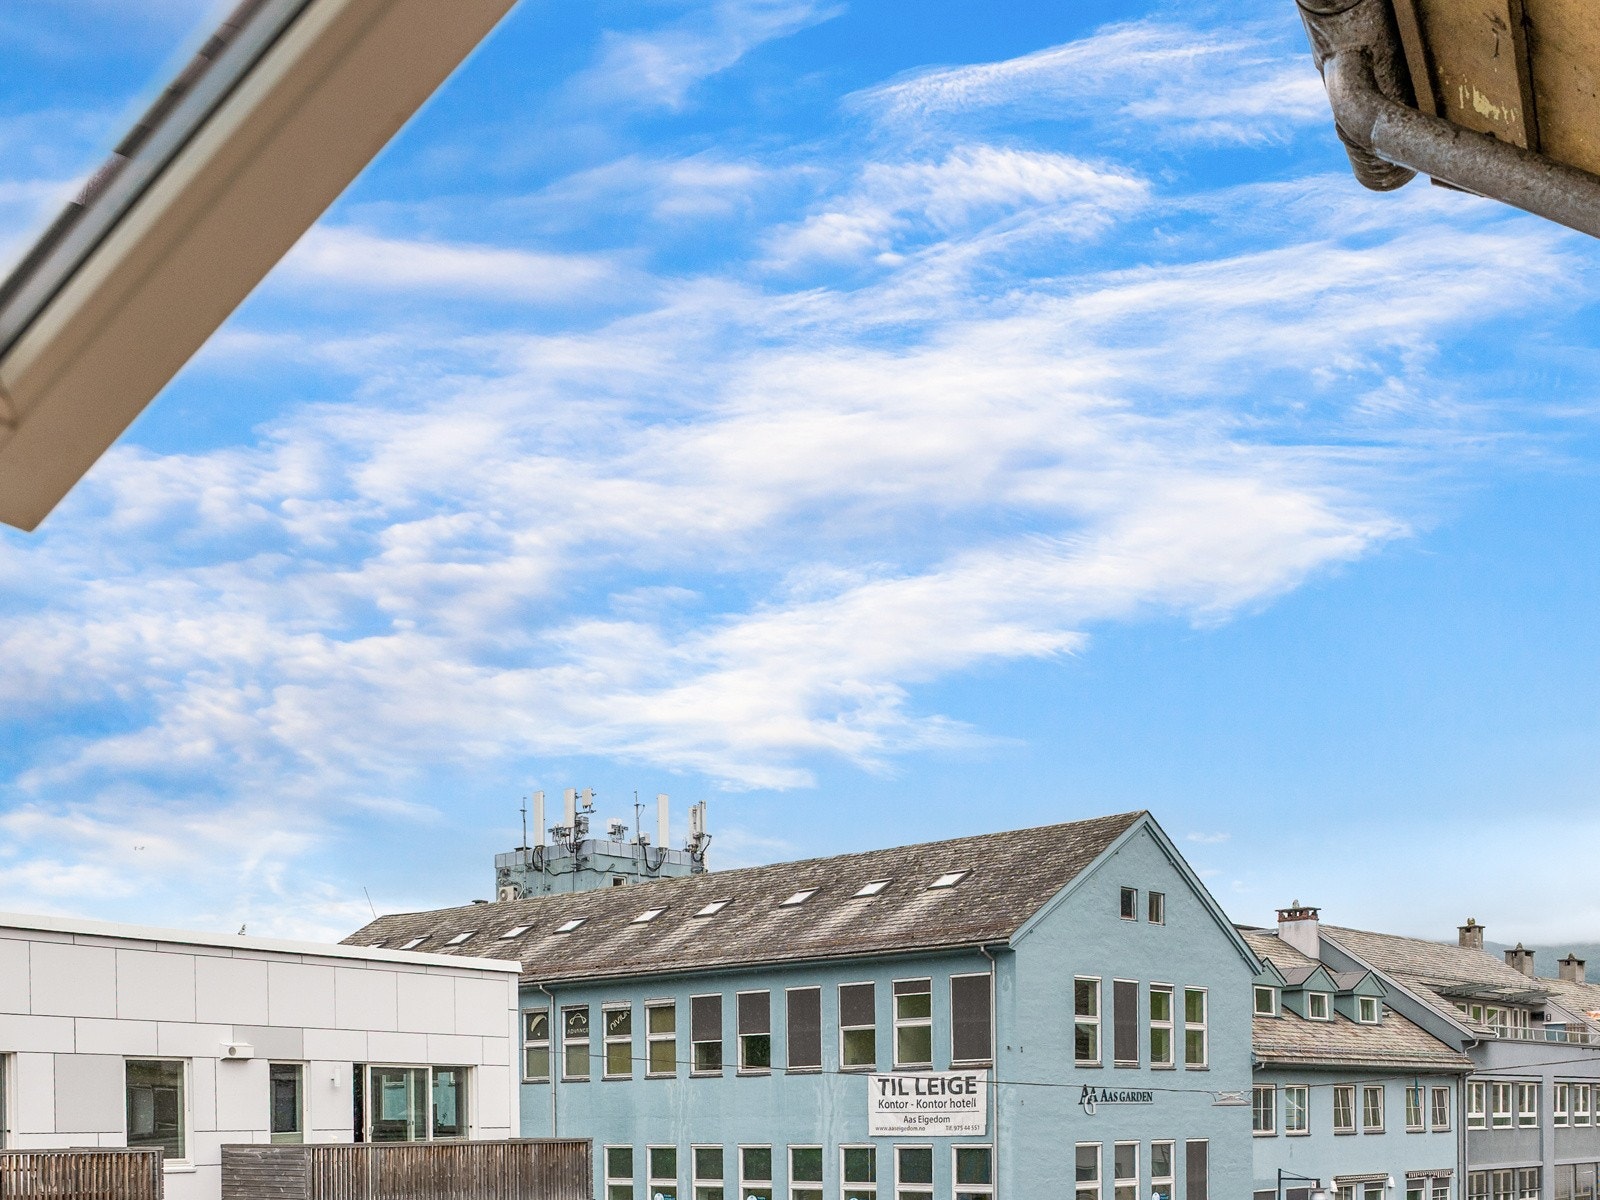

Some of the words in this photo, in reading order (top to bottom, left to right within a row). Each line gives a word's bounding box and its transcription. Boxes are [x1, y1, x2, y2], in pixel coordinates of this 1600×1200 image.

[877, 1078, 909, 1096] TIL
[915, 1076, 978, 1096] LEIGE
[878, 1099, 909, 1109] Kontor
[916, 1099, 947, 1109] Kontor
[949, 1098, 976, 1108] hotell
[903, 1115, 917, 1123] Aas
[918, 1115, 951, 1126] Eigedom
